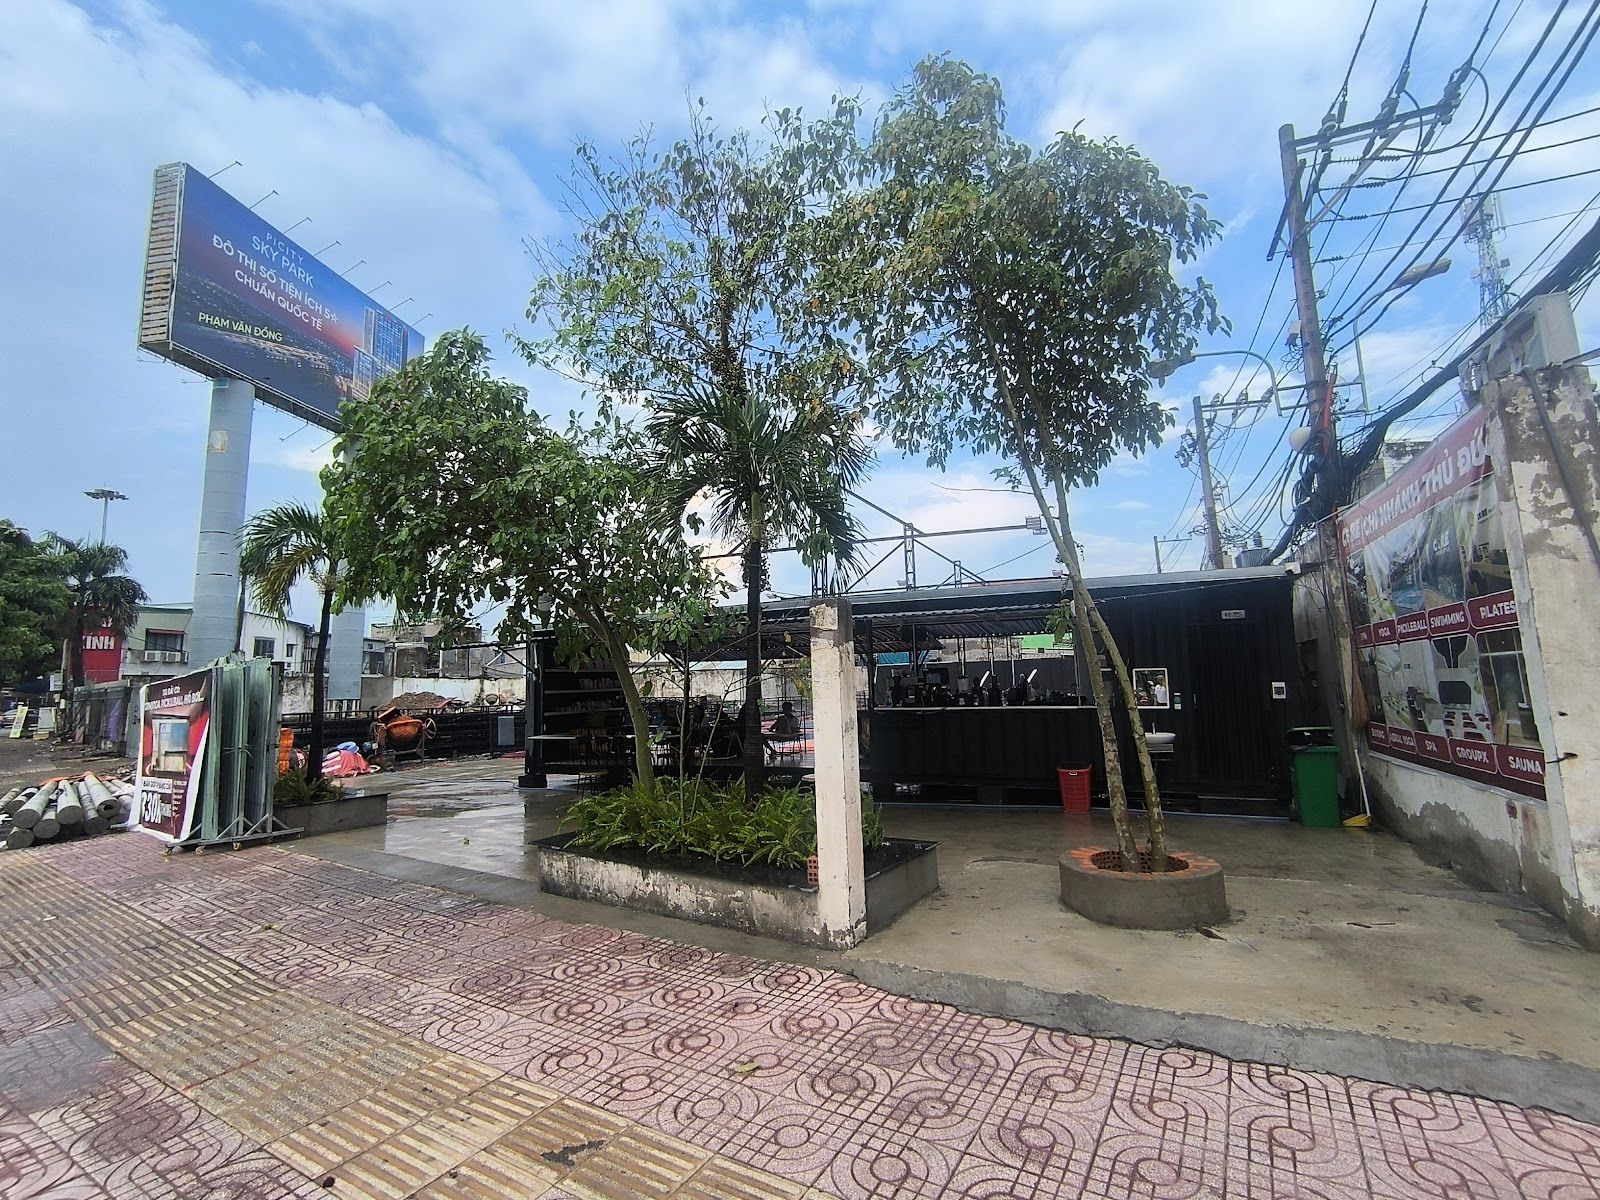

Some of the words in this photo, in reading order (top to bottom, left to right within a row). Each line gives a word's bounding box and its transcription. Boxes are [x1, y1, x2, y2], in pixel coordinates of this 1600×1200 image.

[266, 232, 303, 263] PICITY
[252, 236, 278, 262] SKY
[282, 256, 314, 288] PARK
[213, 234, 234, 256] ĐÔ
[237, 250, 257, 275] THỊ
[279, 277, 302, 300] TIỆN
[304, 292, 322, 314] ÍCH
[198, 312, 230, 328] PHẠM
[232, 320, 252, 334] VĂN
[278, 296, 310, 323] QUỐC
[310, 316, 323, 332] TẾ
[1380, 487, 1421, 526] NHÁNH
[1422, 448, 1454, 497] THỦ
[1457, 427, 1492, 477] ĐỨ
[1398, 619, 1428, 634] PICKLEBALL
[1430, 610, 1465, 628] SWIMMING
[1425, 740, 1438, 752] SPA
[1456, 746, 1489, 764] GROUPX
[1508, 756, 1543, 774] SAUNA
